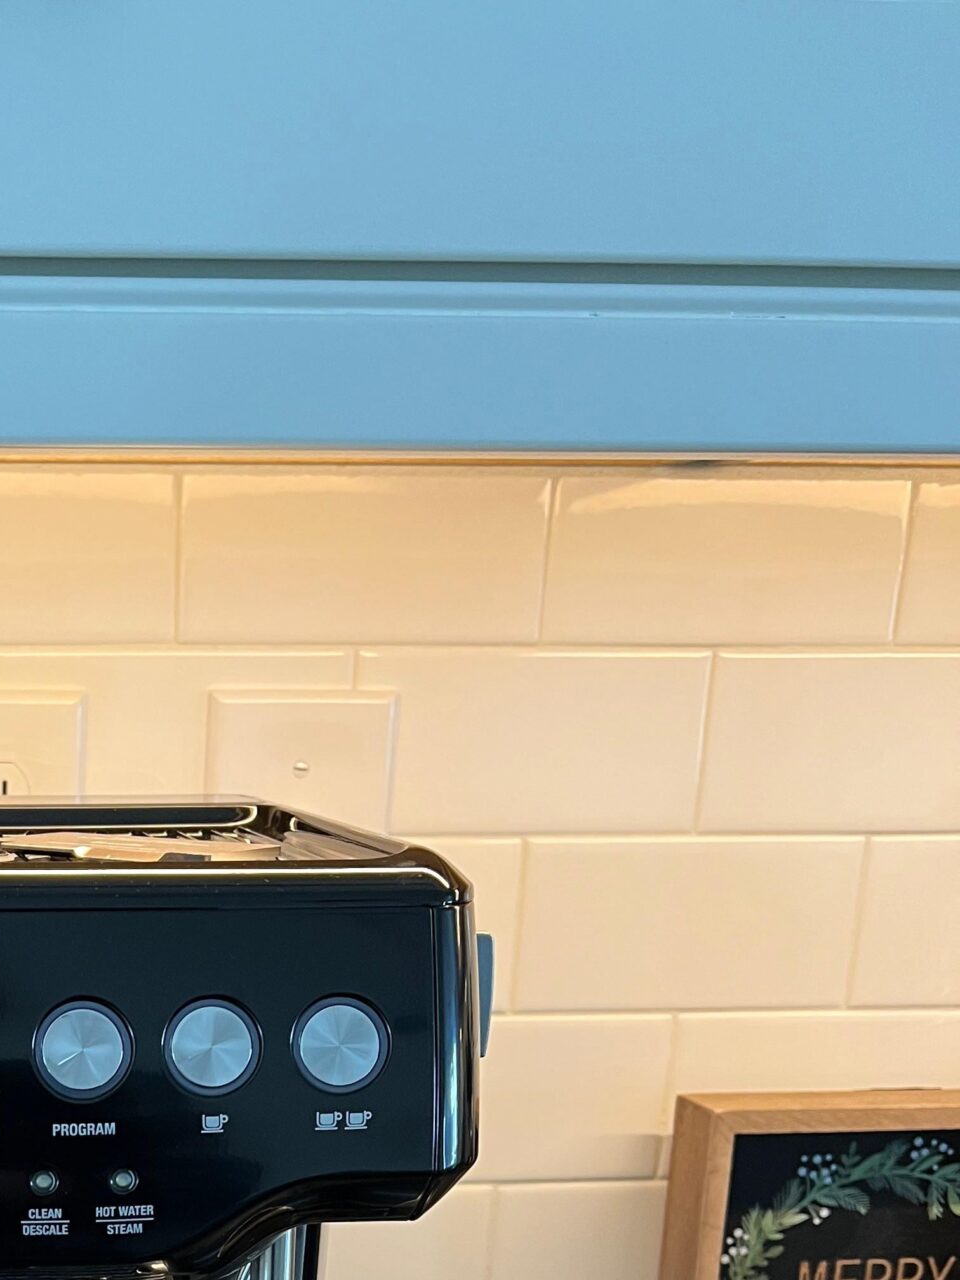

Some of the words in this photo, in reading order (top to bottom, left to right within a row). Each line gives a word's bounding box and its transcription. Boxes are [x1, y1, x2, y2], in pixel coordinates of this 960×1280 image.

[52, 1122, 116, 1137] PROGRAM
[28, 1208, 62, 1219] CLEAN
[95, 1206, 116, 1217] HOT
[118, 1204, 154, 1217] WATER
[22, 1224, 69, 1236] DESCALE
[107, 1223, 143, 1235] STEAM
